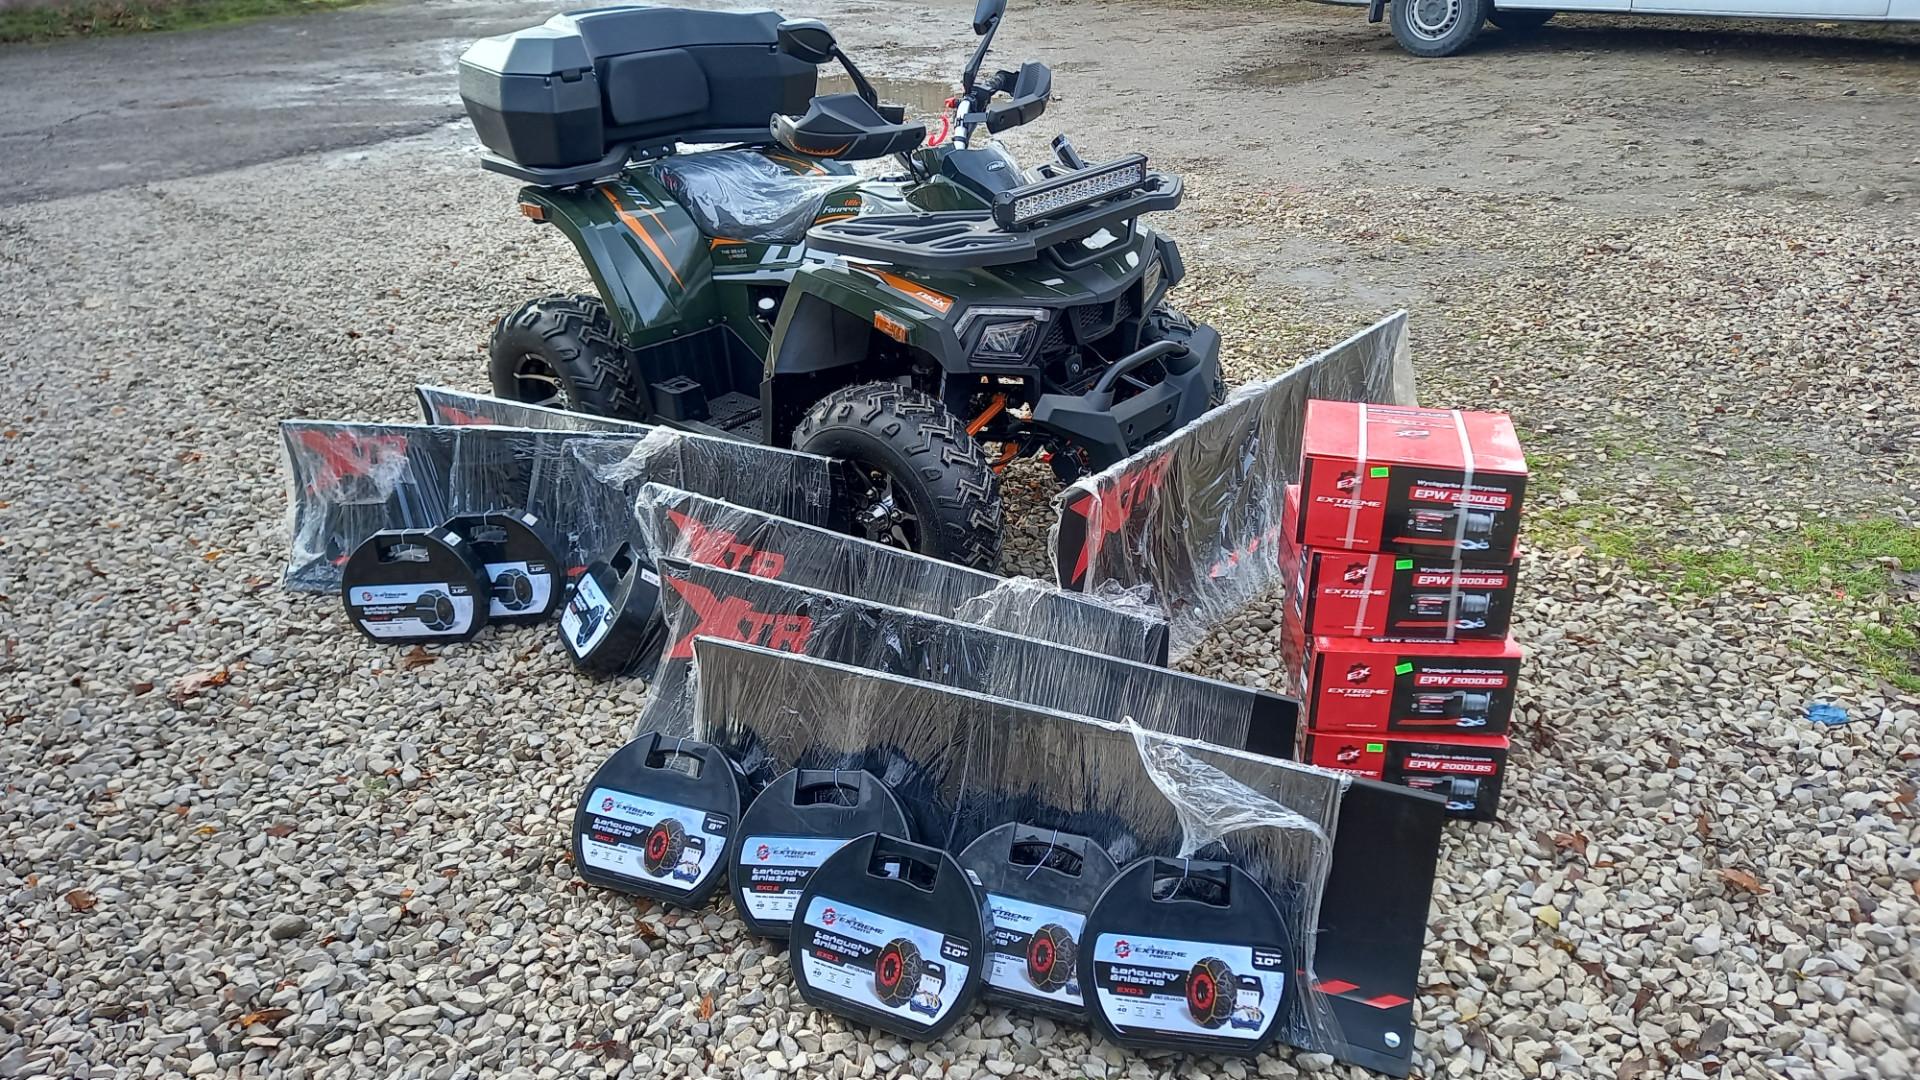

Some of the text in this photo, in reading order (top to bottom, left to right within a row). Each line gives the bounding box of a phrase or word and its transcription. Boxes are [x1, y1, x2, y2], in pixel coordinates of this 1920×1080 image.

[1316, 495, 1382, 508] EXTREME
[1414, 489, 1507, 505] EPW 2000LBS
[1417, 575, 1451, 586] EPW
[1324, 588, 1388, 596] EXTREME
[1419, 676, 1504, 686] EPW 2000LBS
[1327, 687, 1390, 695] EXTREME
[1408, 759, 1493, 772] EPW 2000LBS
[616, 803, 655, 817] EXTREME
[773, 849, 817, 857] EXTREME
[991, 909, 1033, 921] XTREME
[839, 917, 885, 935] EXTREME
[943, 946, 969, 958] 10"
[1135, 947, 1188, 958] EXTREME
[1254, 956, 1282, 968] 10"
